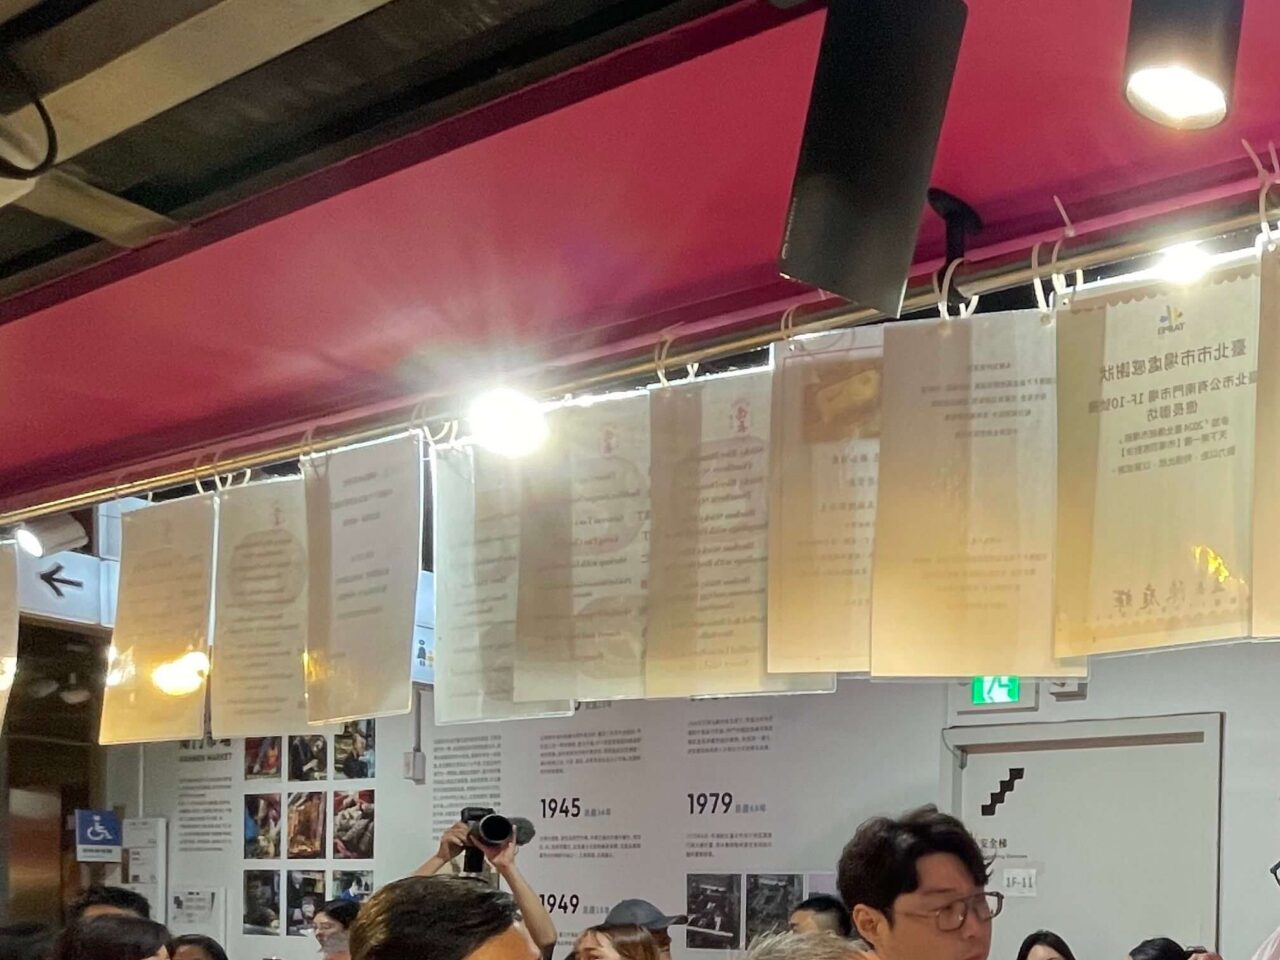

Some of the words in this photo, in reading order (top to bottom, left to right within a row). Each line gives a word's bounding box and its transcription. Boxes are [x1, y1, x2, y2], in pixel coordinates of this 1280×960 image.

[540, 798, 581, 818] 1945
[687, 792, 733, 815] 1979
[1005, 876, 1033, 889] 1F-11
[539, 894, 579, 914] 1949
